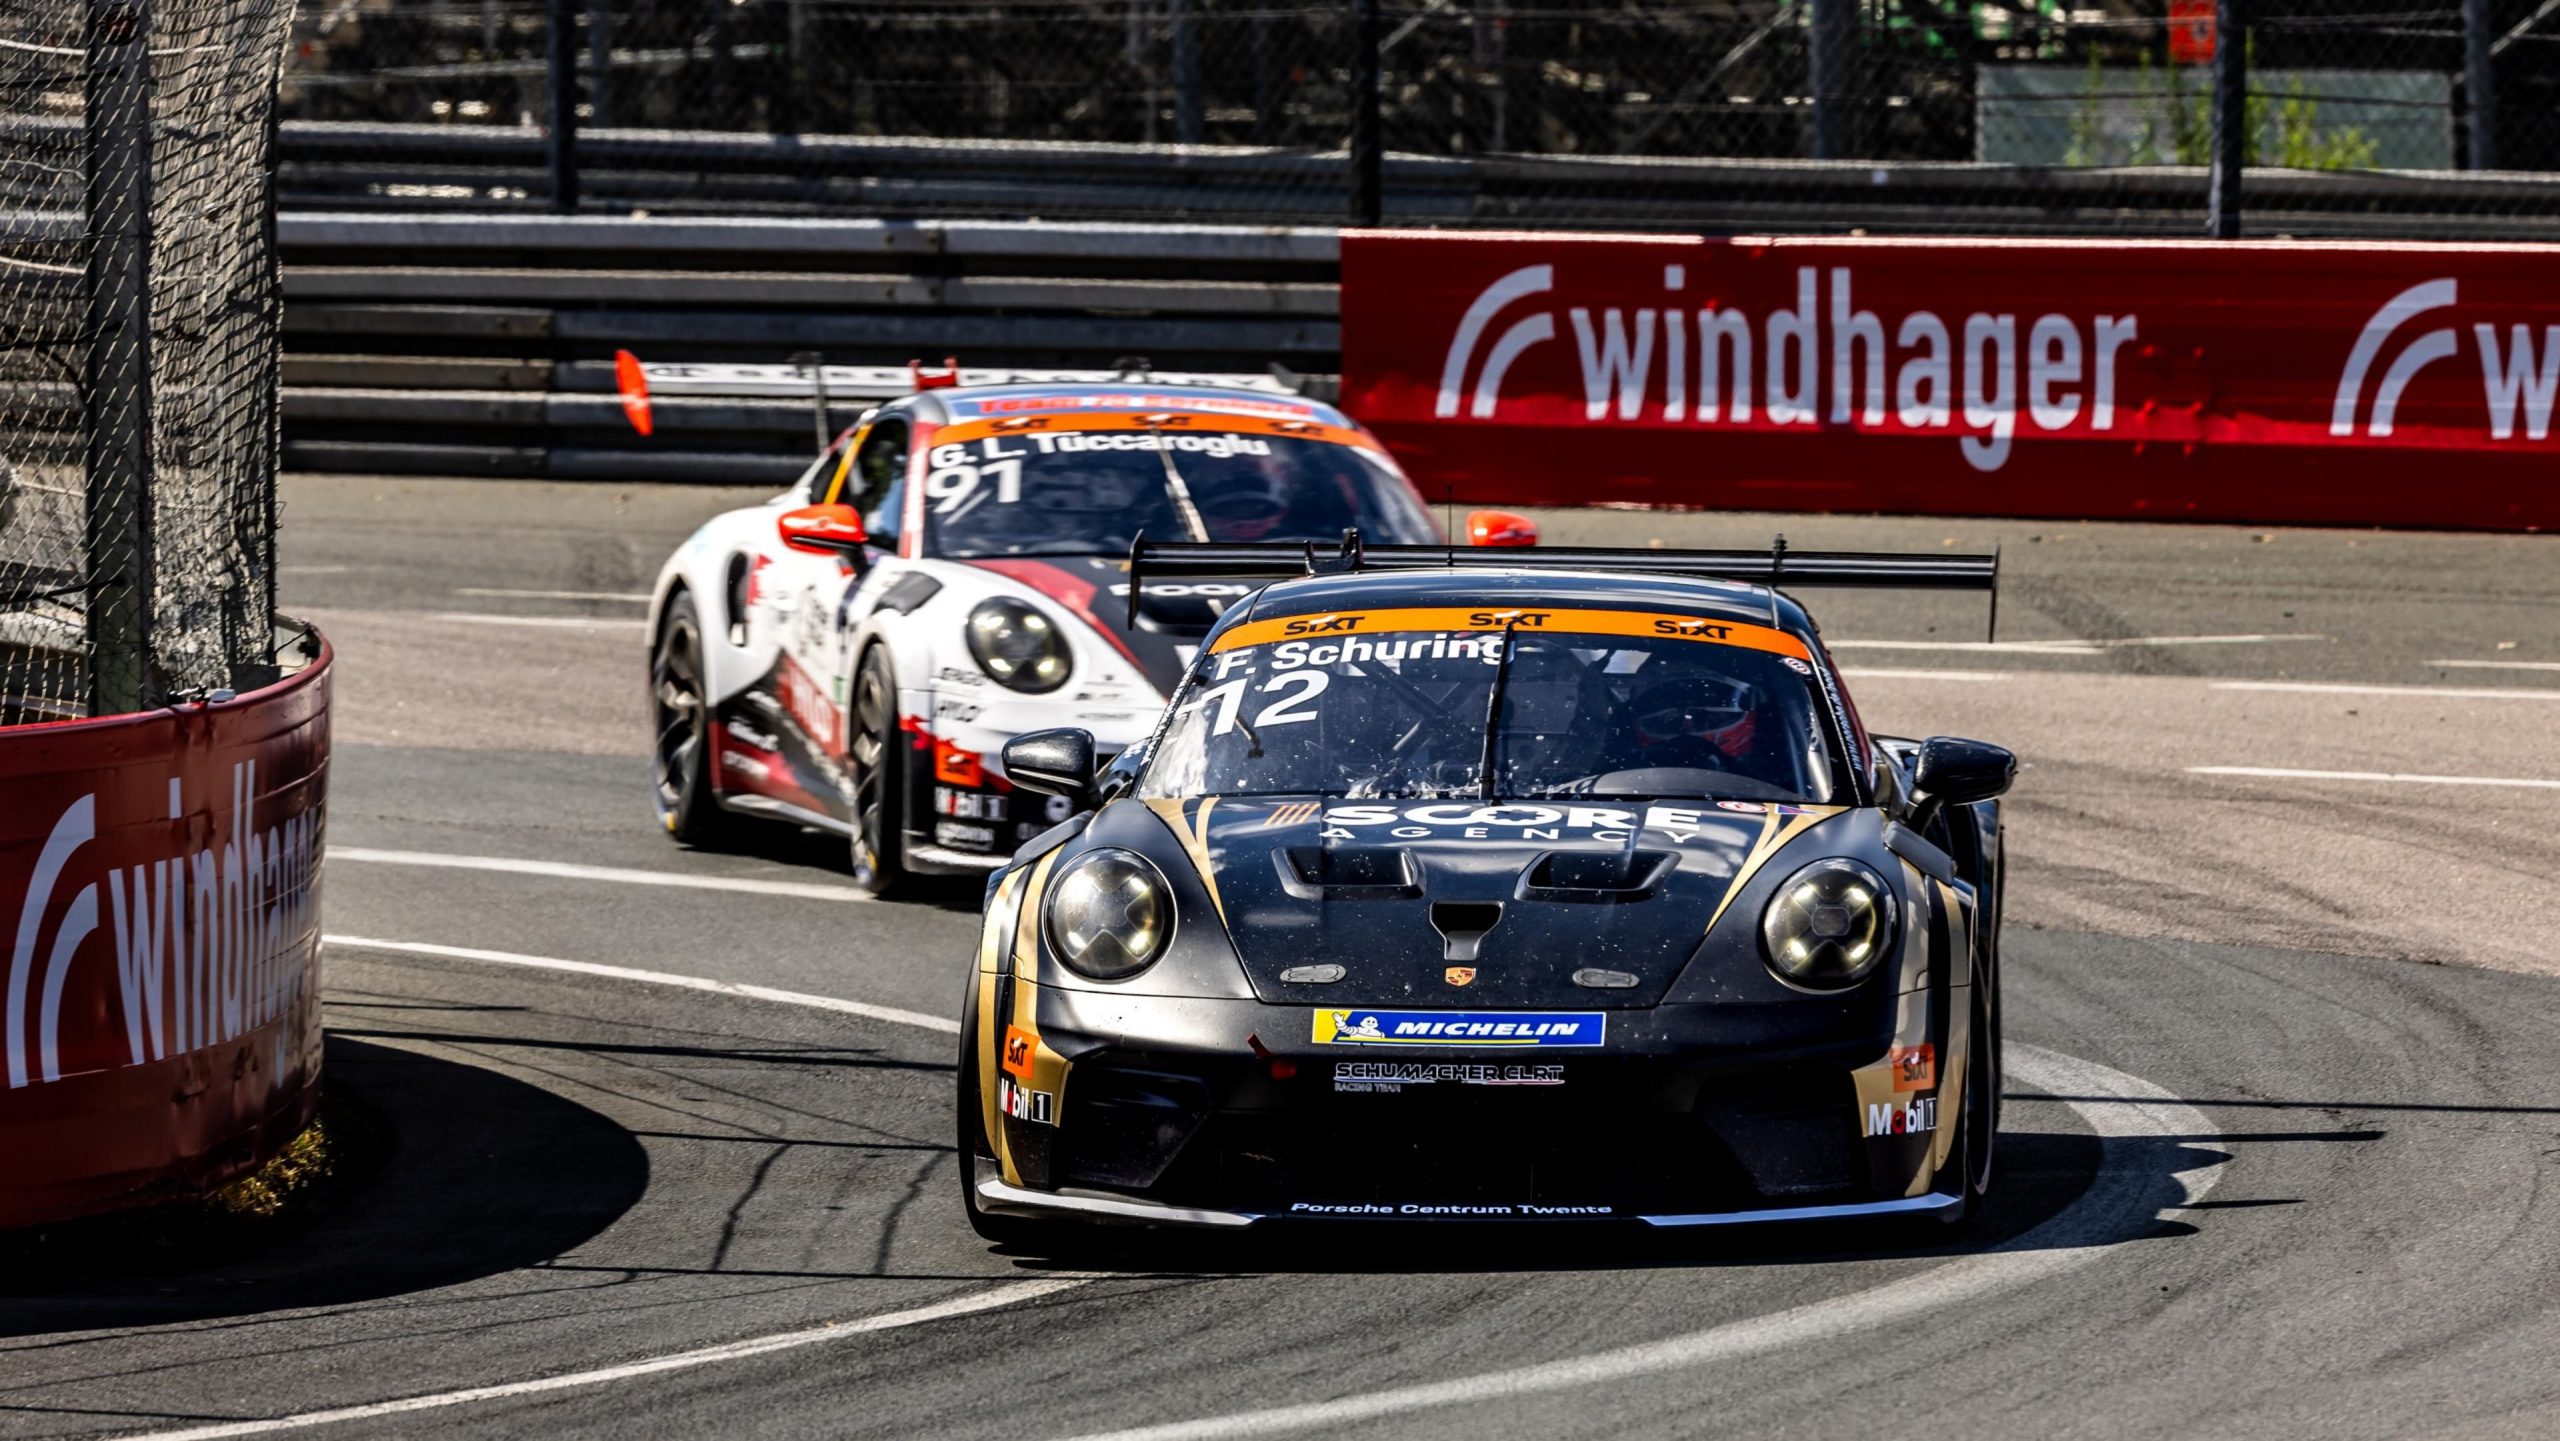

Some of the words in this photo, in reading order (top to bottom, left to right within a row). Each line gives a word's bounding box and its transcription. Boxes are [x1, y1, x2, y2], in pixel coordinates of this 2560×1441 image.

[1569, 264, 2137, 471] windhager
[930, 443, 979, 468] G.
[925, 459, 1022, 513] 91
[1215, 649, 1256, 681] F.
[1271, 633, 1507, 670] Schuring
[1201, 669, 1330, 736] 12
[1322, 804, 1700, 830] SCORE
[1319, 827, 1697, 843] AGENCY
[1394, 1021, 1580, 1036] MICHELIN
[1334, 1062, 1500, 1081] SCHUMACHER
[1000, 1077, 1030, 1121] Mobil
[1868, 1099, 1925, 1136] Mobil
[1290, 1202, 1394, 1215] Porsche
[1400, 1203, 1512, 1215] Centrum
[1517, 1204, 1613, 1215] Twente
